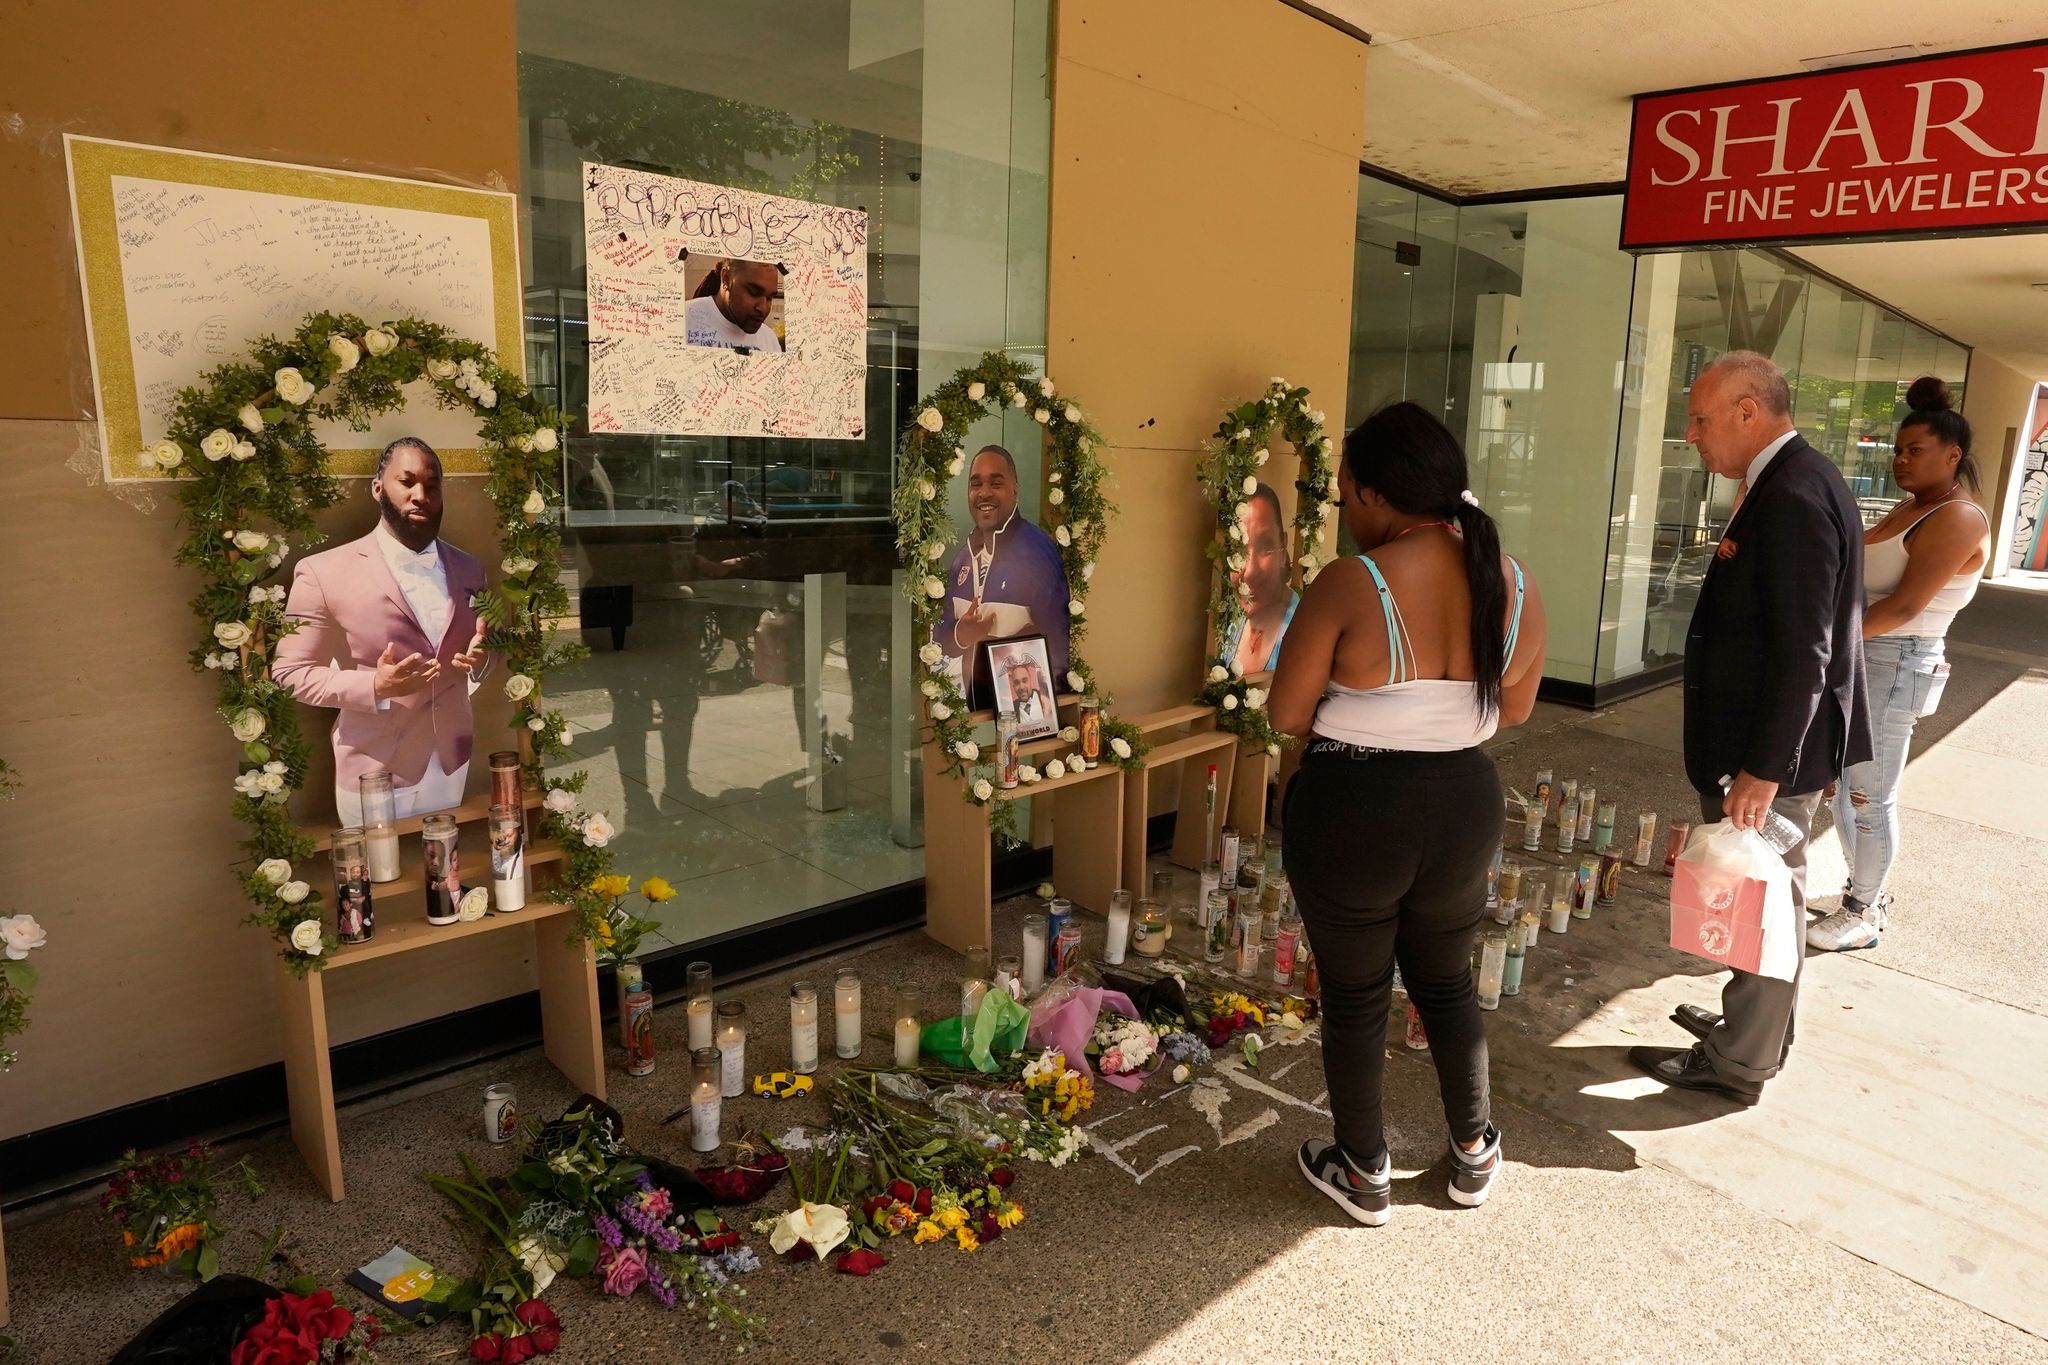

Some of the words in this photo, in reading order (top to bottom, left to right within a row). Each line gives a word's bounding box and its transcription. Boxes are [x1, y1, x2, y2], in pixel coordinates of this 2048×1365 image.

[1704, 186, 1795, 224] FINE
[1810, 167, 2048, 218] JEWELERS
[386, 1270, 433, 1300] LIFE
